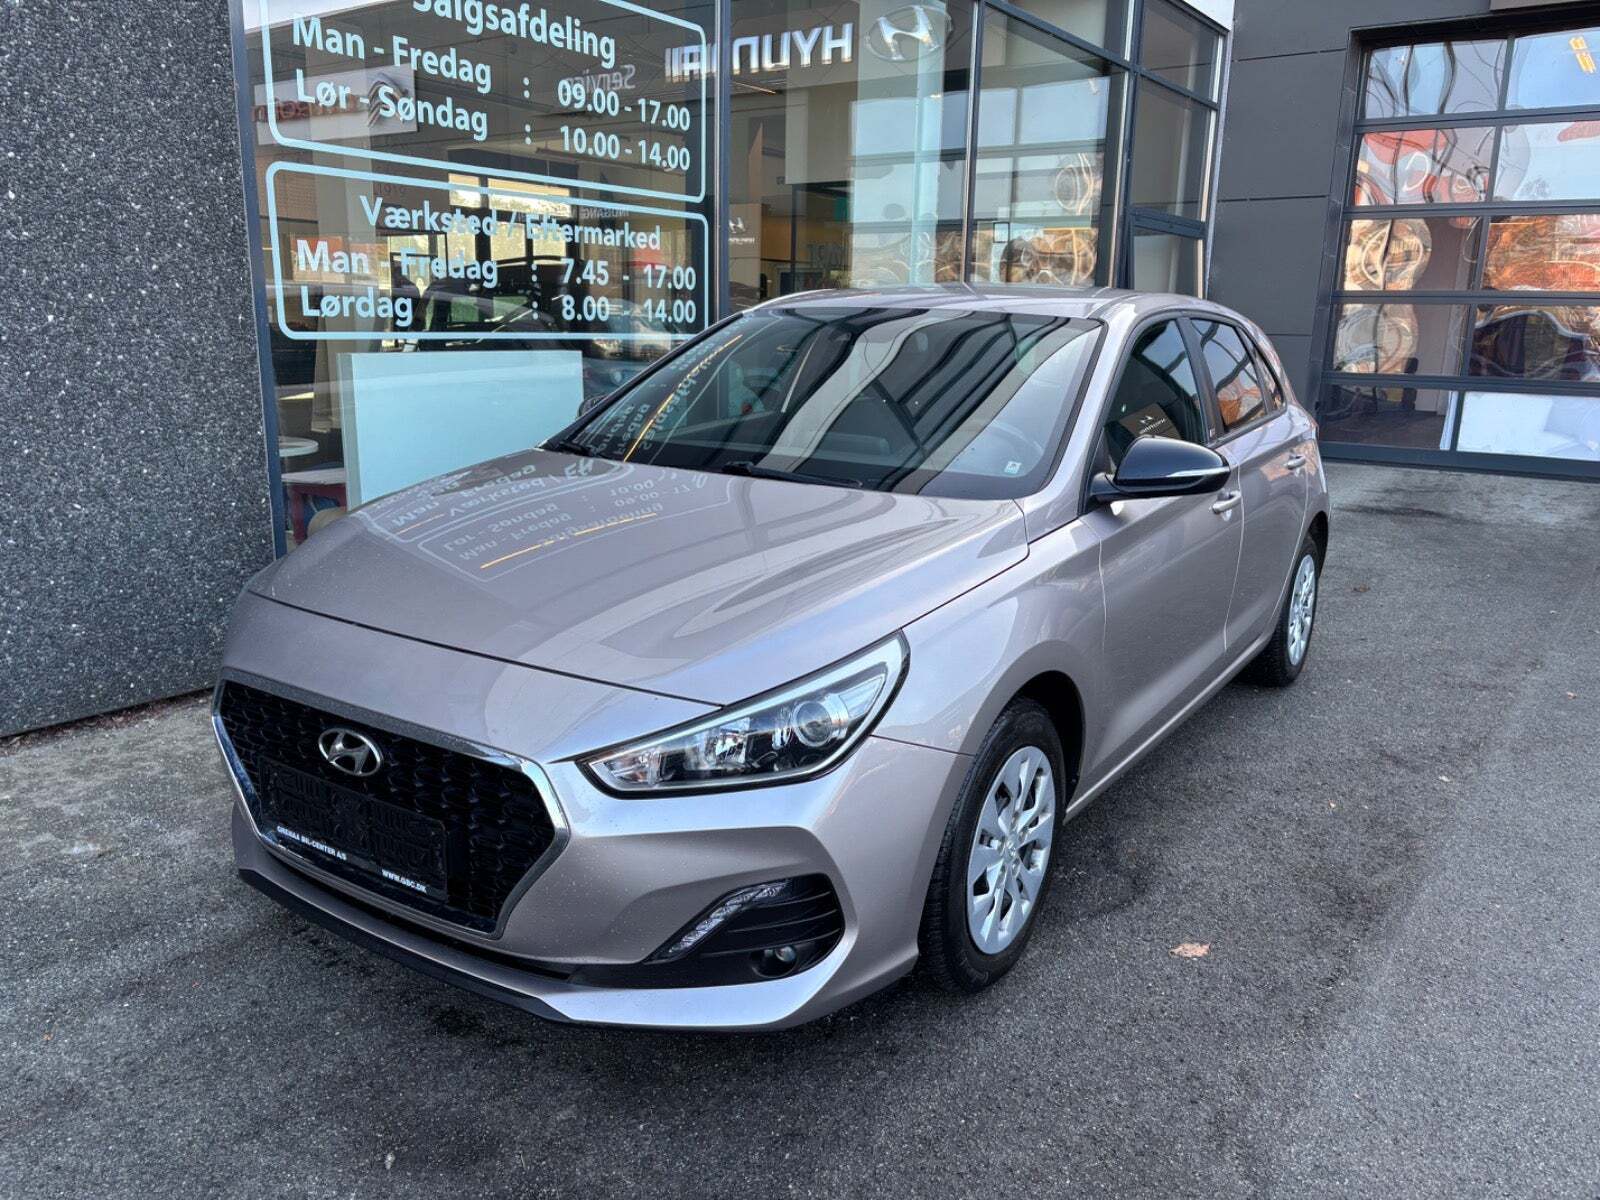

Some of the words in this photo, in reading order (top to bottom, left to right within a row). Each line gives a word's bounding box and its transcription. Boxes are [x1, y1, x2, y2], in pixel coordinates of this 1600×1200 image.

[293, 17, 365, 60] Man
[392, 35, 493, 94] Fredag
[557, 79, 620, 117] 09.00
[638, 98, 691, 132] 17.00
[296, 68, 351, 110] Lør
[378, 85, 488, 142] Søndag
[560, 125, 621, 160] 10.00
[638, 139, 691, 171] 14.00
[359, 195, 498, 237] Værksted
[525, 212, 662, 250] Eftermarked
[296, 239, 370, 275] Man
[400, 247, 498, 289] Fredag
[560, 257, 609, 286] 7.45
[643, 264, 697, 290] 17.00
[300, 286, 414, 327] Lørdag
[561, 295, 610, 322] 8.00
[643, 298, 697, 324] 14.00
